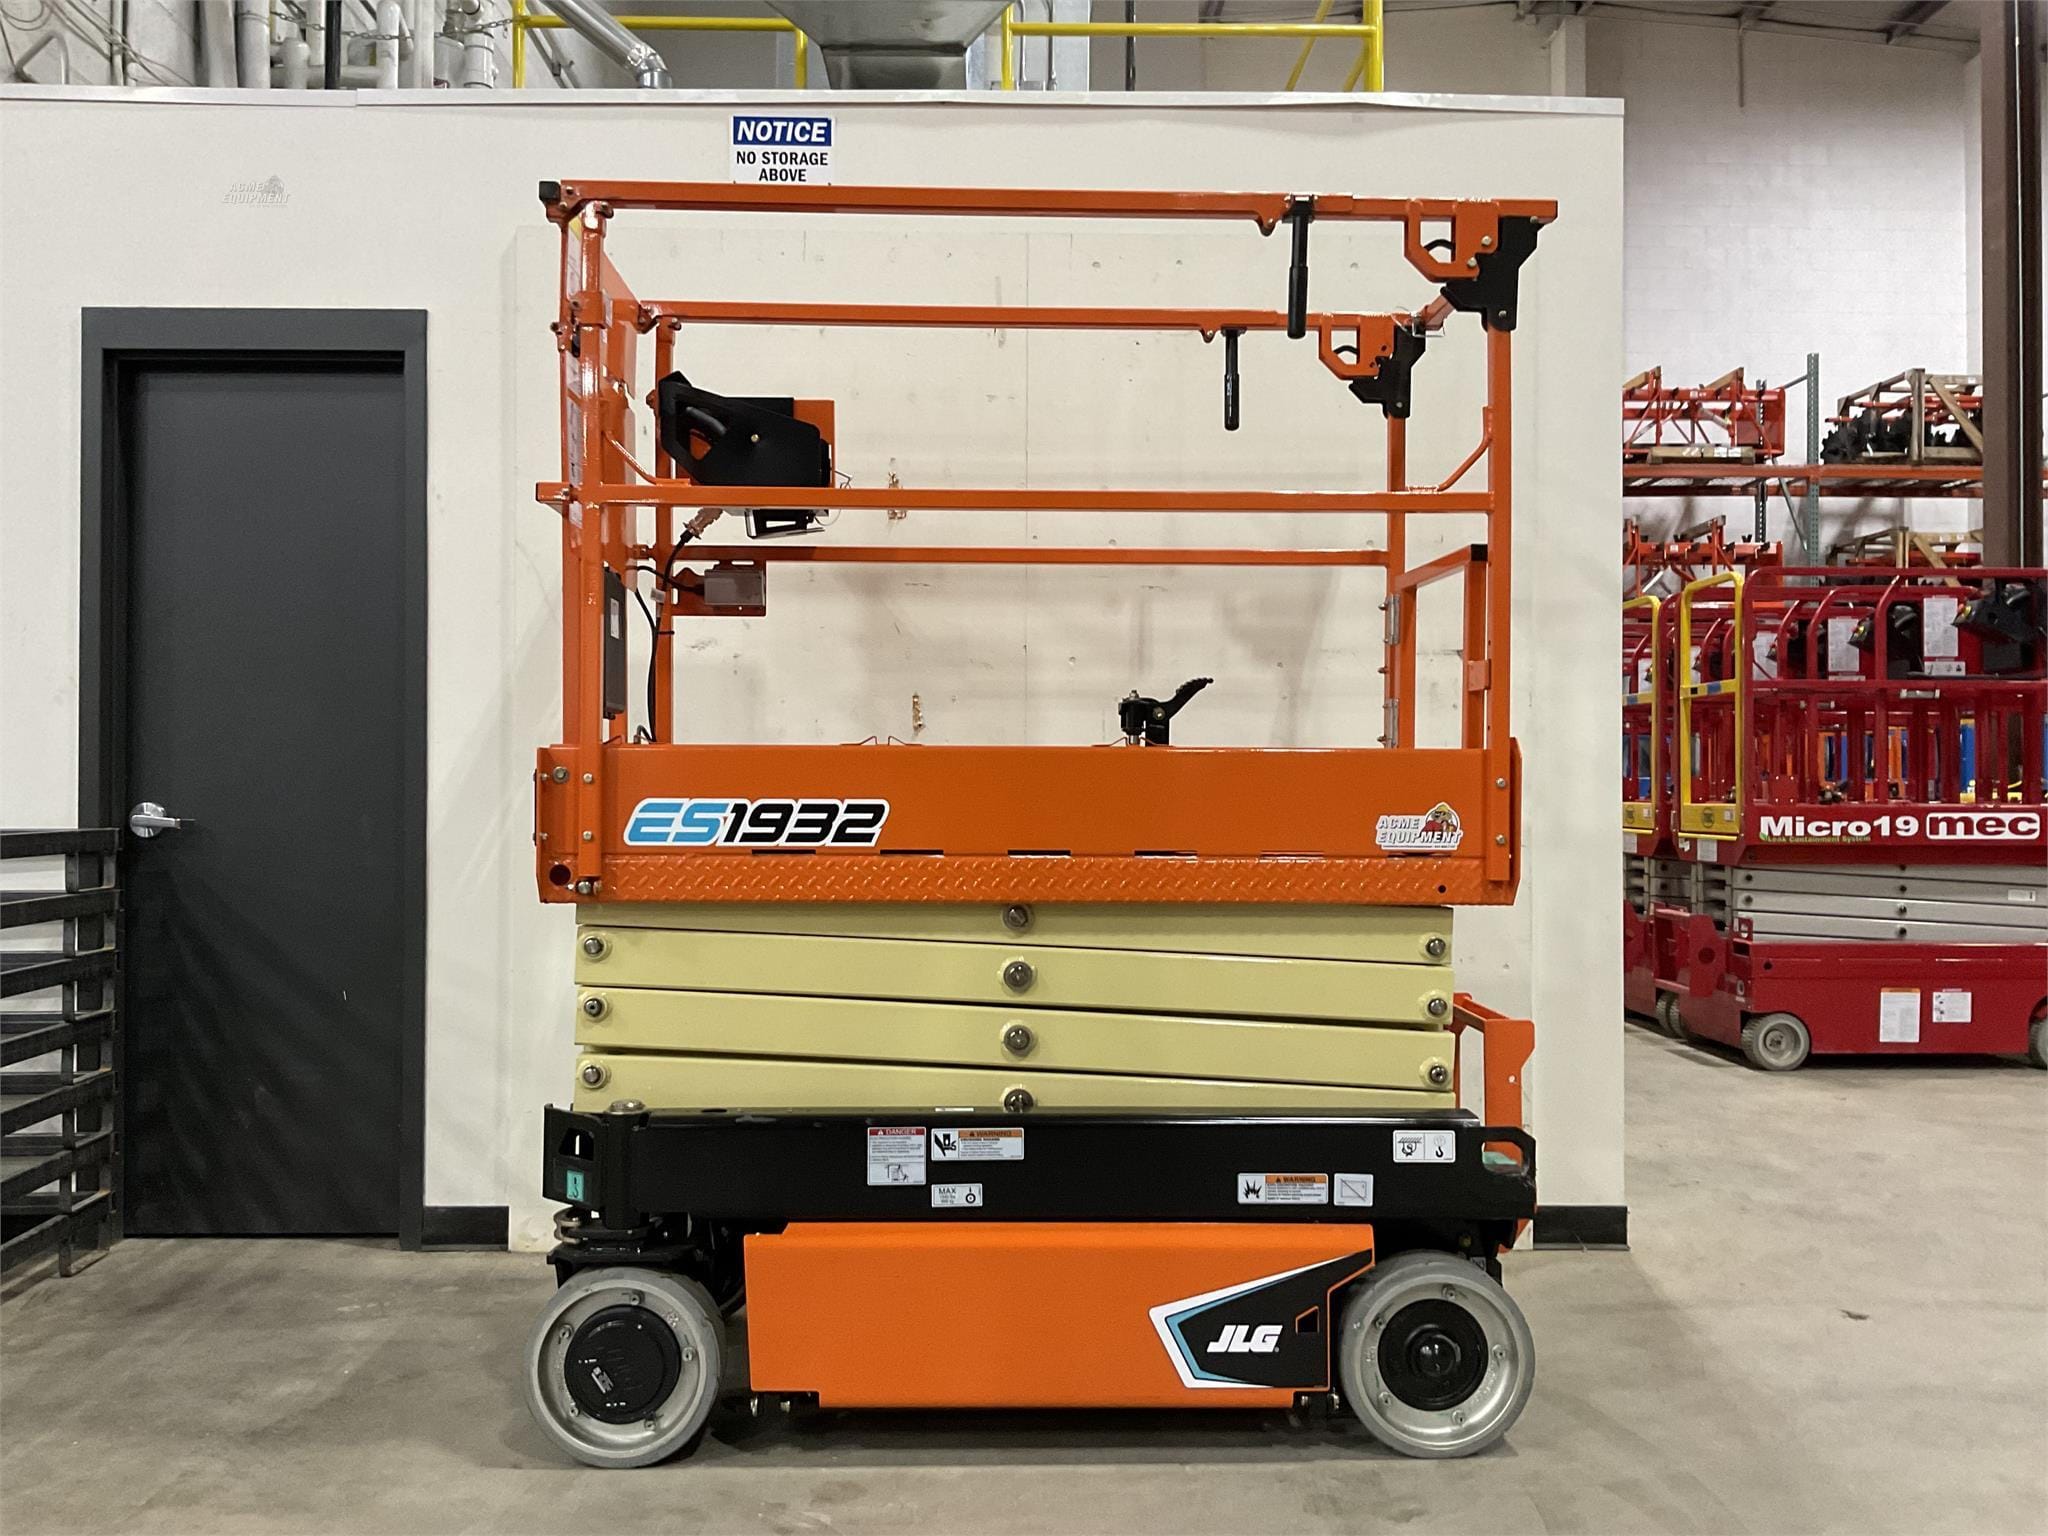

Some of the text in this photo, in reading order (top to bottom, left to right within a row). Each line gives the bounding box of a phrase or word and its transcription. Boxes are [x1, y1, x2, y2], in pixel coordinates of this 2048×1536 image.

[737, 120, 828, 143] NOTICE
[736, 151, 829, 166] NO STORAGE
[759, 168, 807, 182] ABOVE
[627, 801, 887, 844] ES1932
[1378, 817, 1420, 830] ACME
[1759, 815, 2038, 837] Micro19 mec
[1377, 831, 1461, 845] EQUIPMENT
[885, 1128, 917, 1136] DANGER
[976, 1130, 1012, 1138] WARNING
[1282, 1175, 1316, 1183] WARNING
[938, 1187, 957, 1195] MAX
[1206, 1324, 1284, 1353] JLG
